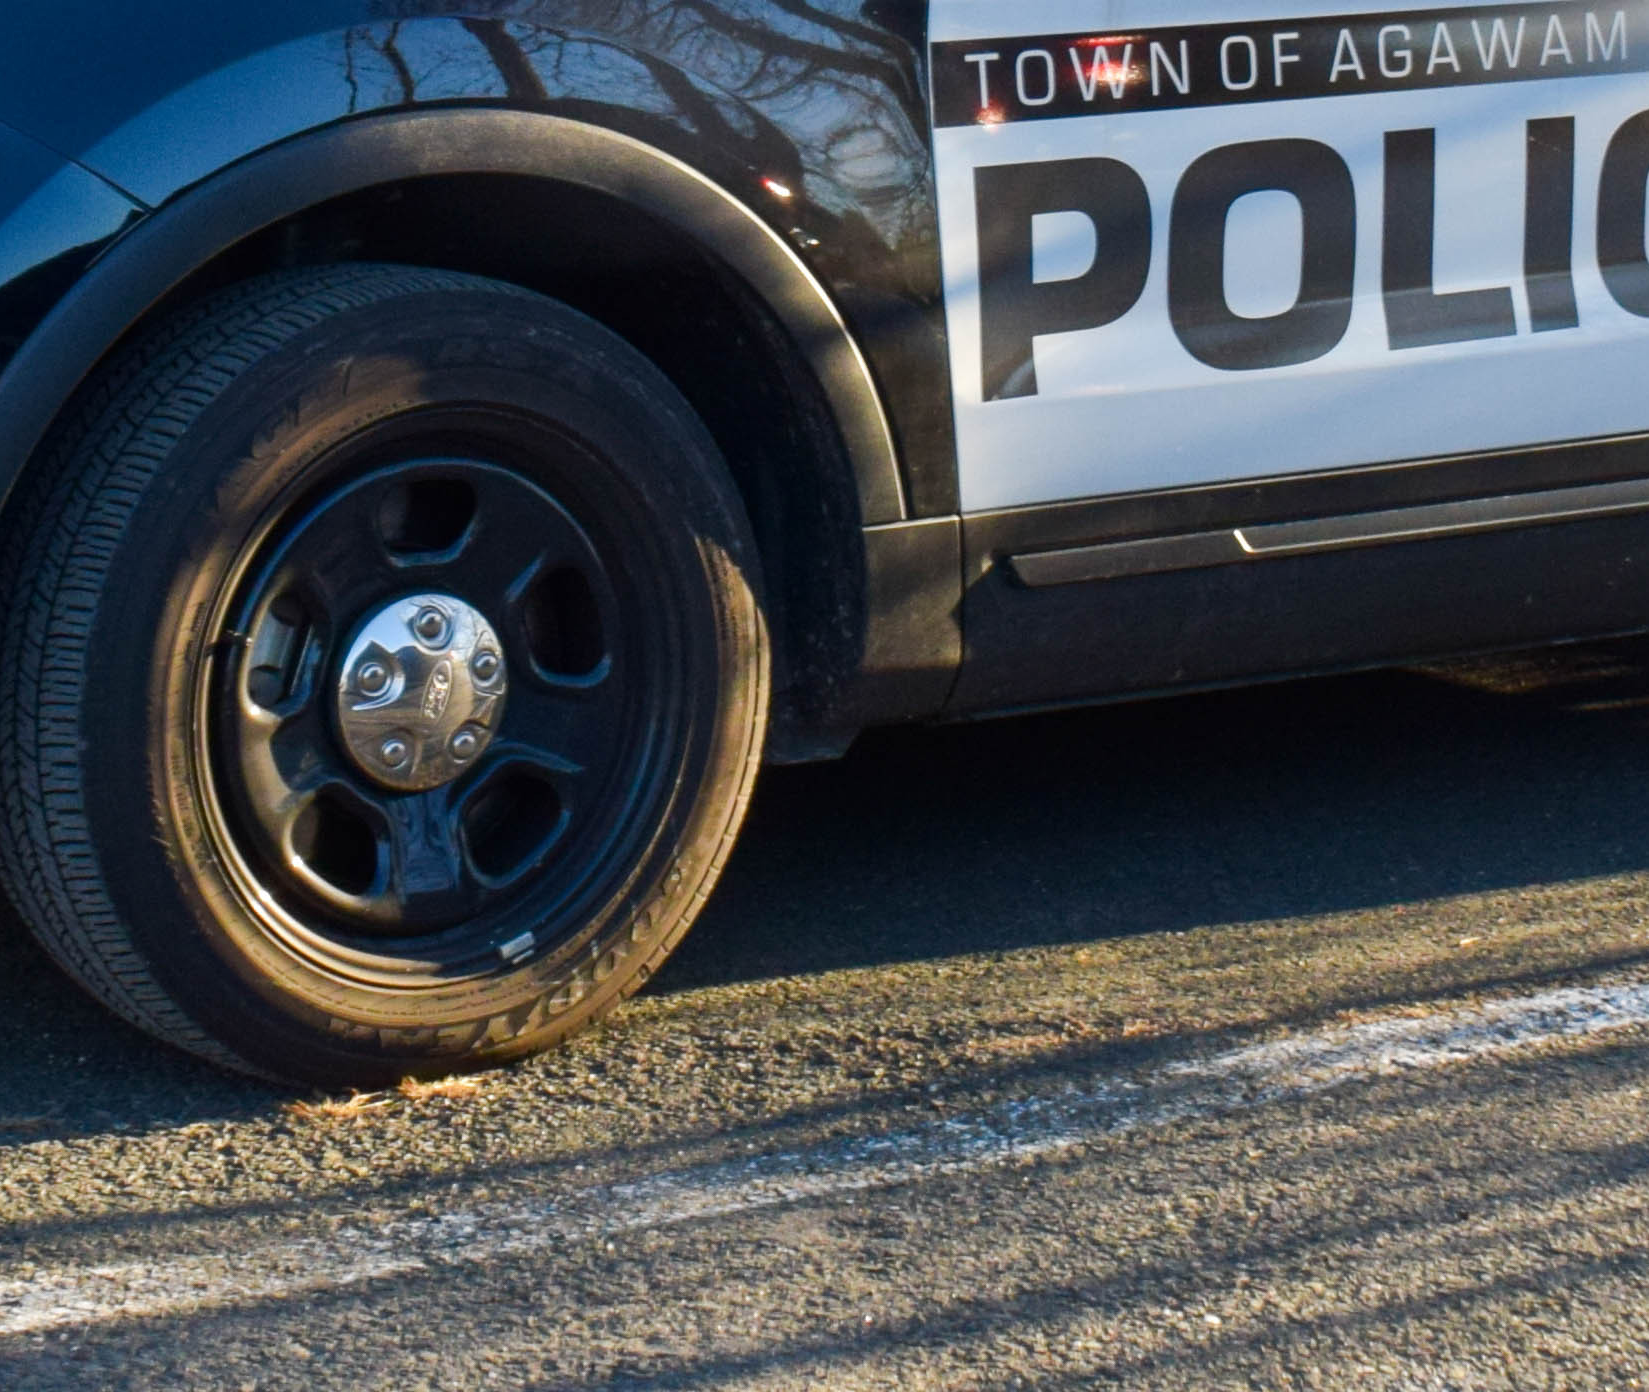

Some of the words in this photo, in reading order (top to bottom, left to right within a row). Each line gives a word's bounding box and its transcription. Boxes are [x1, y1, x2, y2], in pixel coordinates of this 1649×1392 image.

[964, 39, 1191, 109] TOWN
[1219, 32, 1303, 92] OF
[1328, 10, 1629, 84] AGAWAM
